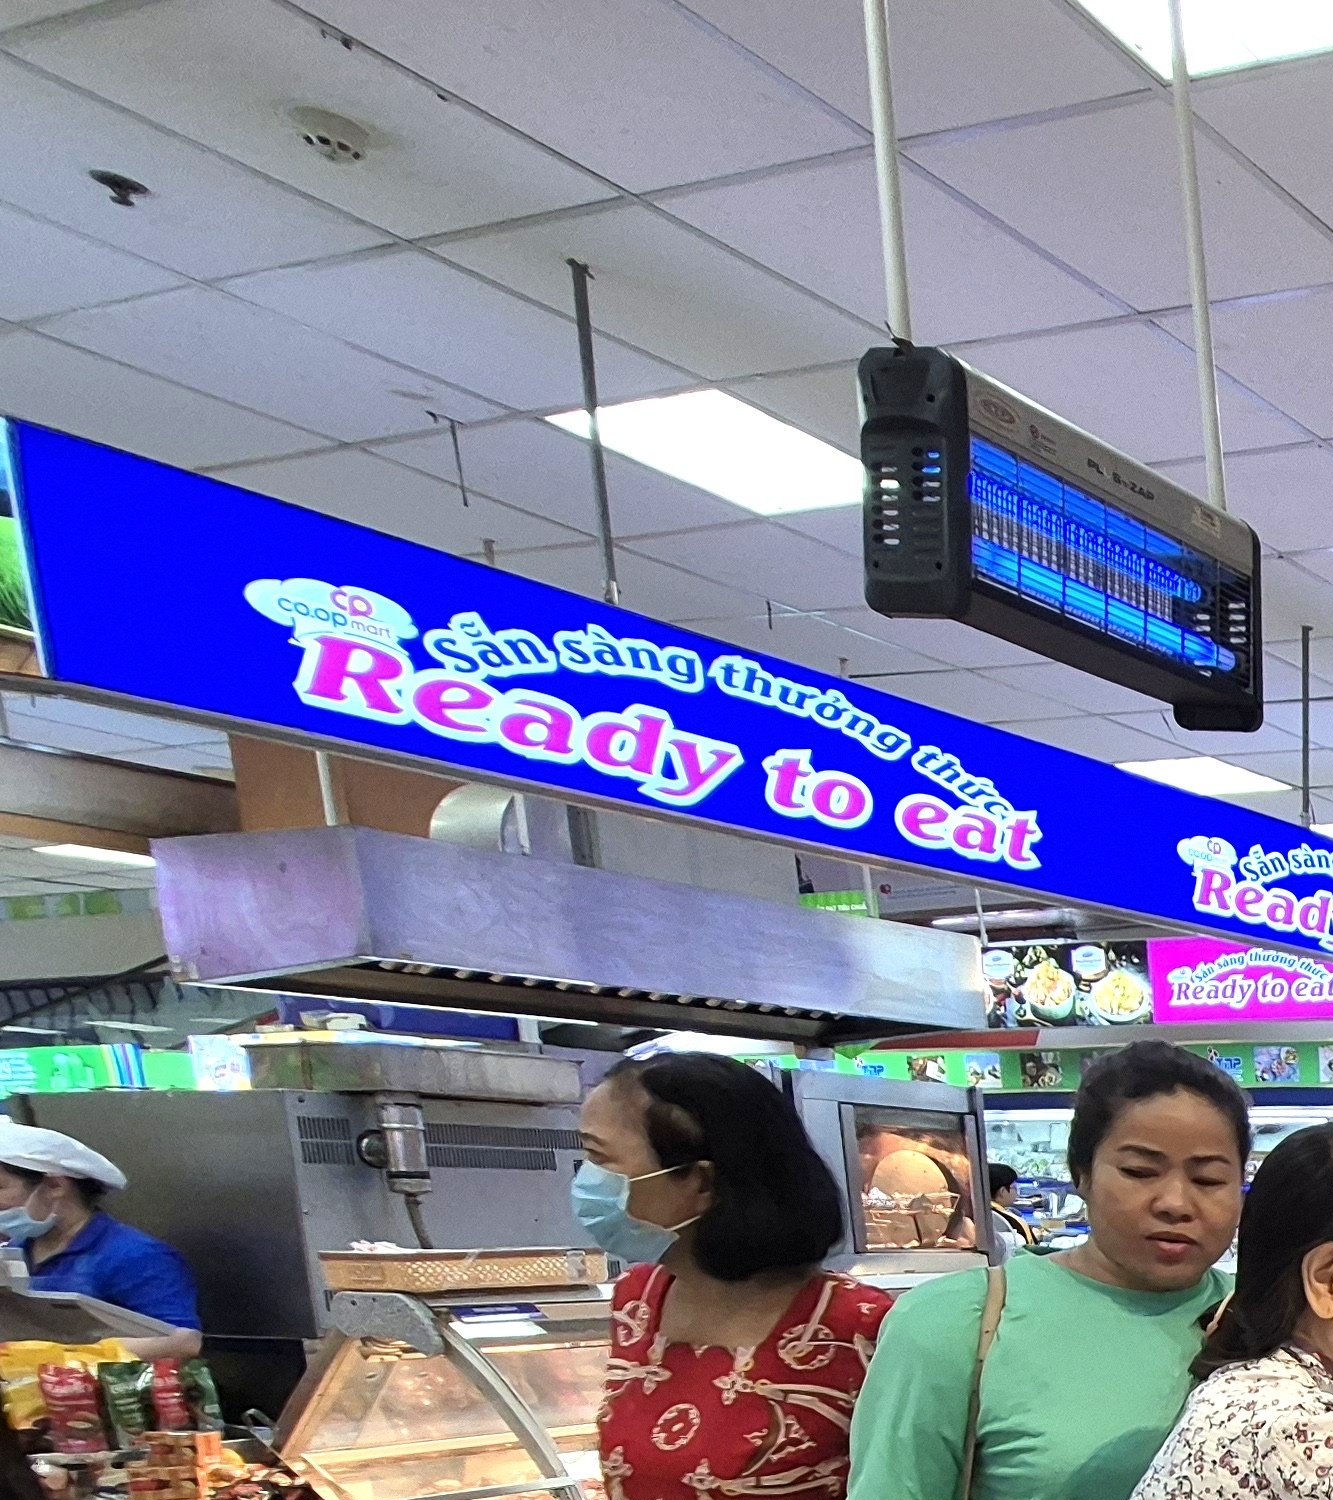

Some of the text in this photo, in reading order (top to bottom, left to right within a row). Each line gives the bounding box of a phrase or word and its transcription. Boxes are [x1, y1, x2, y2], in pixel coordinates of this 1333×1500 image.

[435, 622, 1016, 820] Sẵn sàng thưởng thức
[304, 636, 1036, 862] Ready to eat
[1244, 851, 1286, 881] Sẵn
[1217, 954, 1244, 969] sàng
[1250, 950, 1296, 967] thưởng
[1176, 978, 1253, 1004] Ready
[1261, 979, 1284, 998] to
